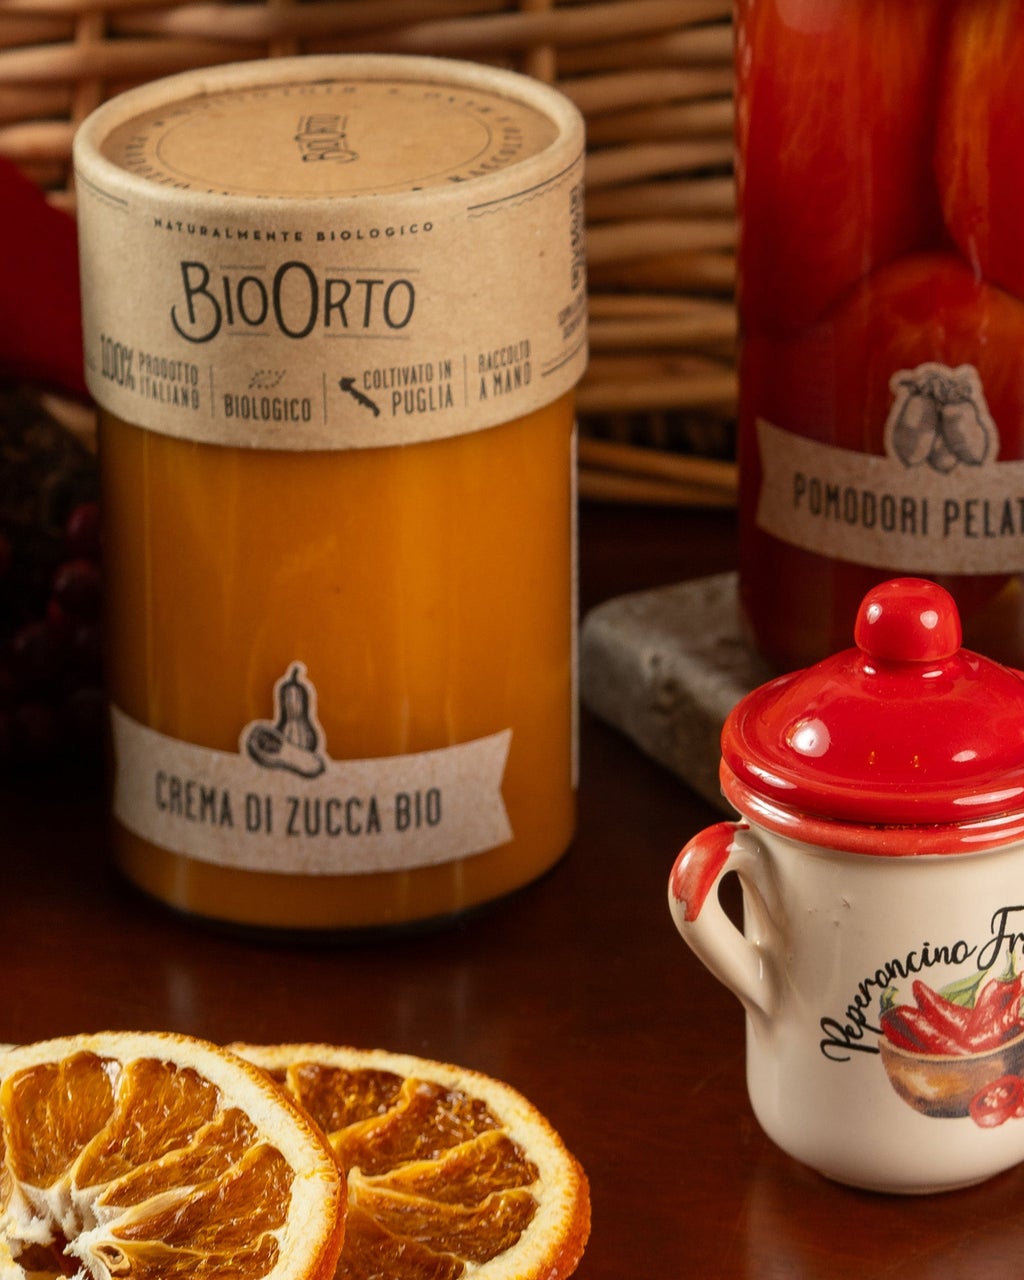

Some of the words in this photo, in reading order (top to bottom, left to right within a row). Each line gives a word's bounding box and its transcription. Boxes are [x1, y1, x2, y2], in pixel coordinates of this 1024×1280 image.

[154, 217, 303, 243] NATURALMENTE
[316, 221, 435, 243] BIOLOGICO
[101, 333, 136, 391] 100%
[138, 351, 200, 387] PRODOTTO
[477, 338, 531, 372] RACCOLTO
[363, 364, 433, 391] COLTIVATO
[438, 359, 452, 384] IN
[479, 379, 487, 401] A
[493, 360, 532, 397] MANO
[140, 376, 200, 411] ITALIANO
[224, 393, 312, 422] BIOLOGICO
[391, 382, 454, 417] PUGLIA
[794, 472, 929, 535] POMODORI
[154, 770, 234, 828] CREMA
[245, 793, 274, 835] DI
[285, 795, 383, 838] ZUCCA
[394, 787, 443, 828] BIO
[820, 940, 977, 1062] Peperoncino
